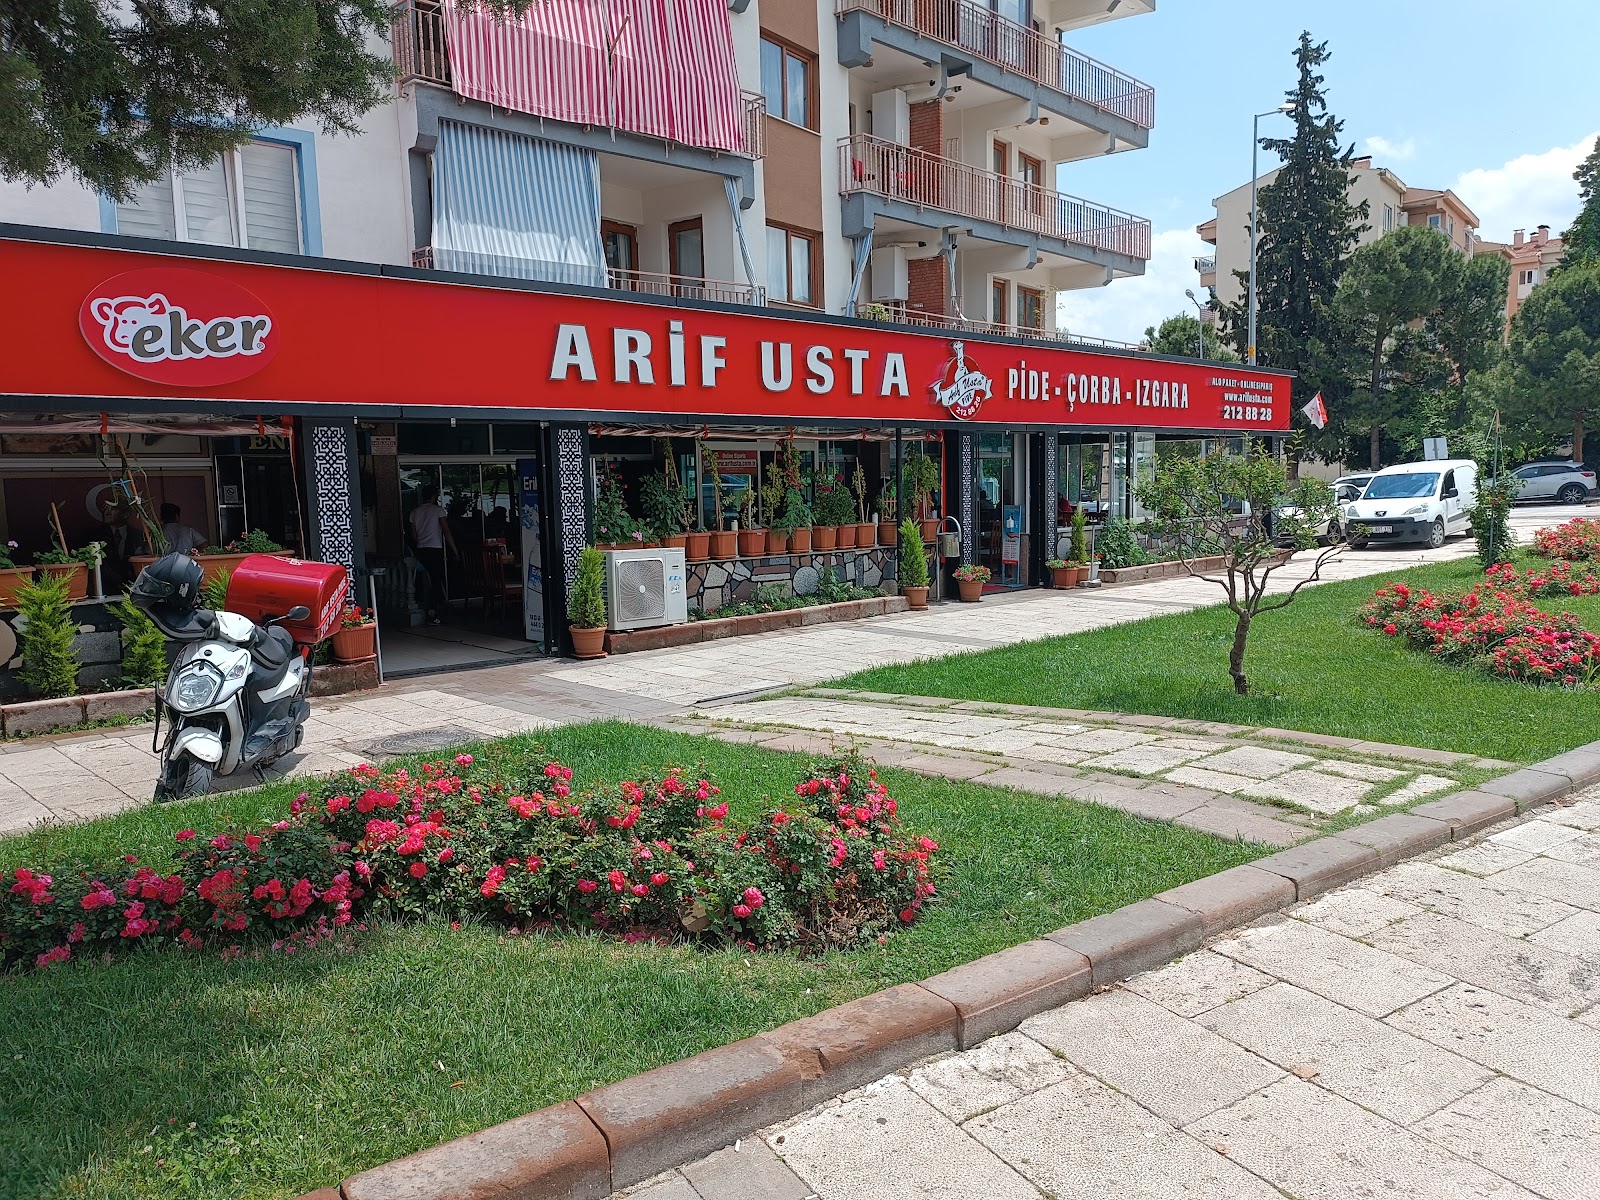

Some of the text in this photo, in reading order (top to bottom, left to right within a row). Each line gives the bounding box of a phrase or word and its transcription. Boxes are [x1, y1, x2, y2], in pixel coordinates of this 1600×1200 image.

[131, 310, 267, 359] eker
[549, 319, 911, 398] ARİF USTA
[1008, 360, 1050, 401] PİDE
[1067, 372, 1121, 412] ÇORBA
[1136, 378, 1189, 409] IZGARA
[1223, 405, 1272, 421] 212 88 28
